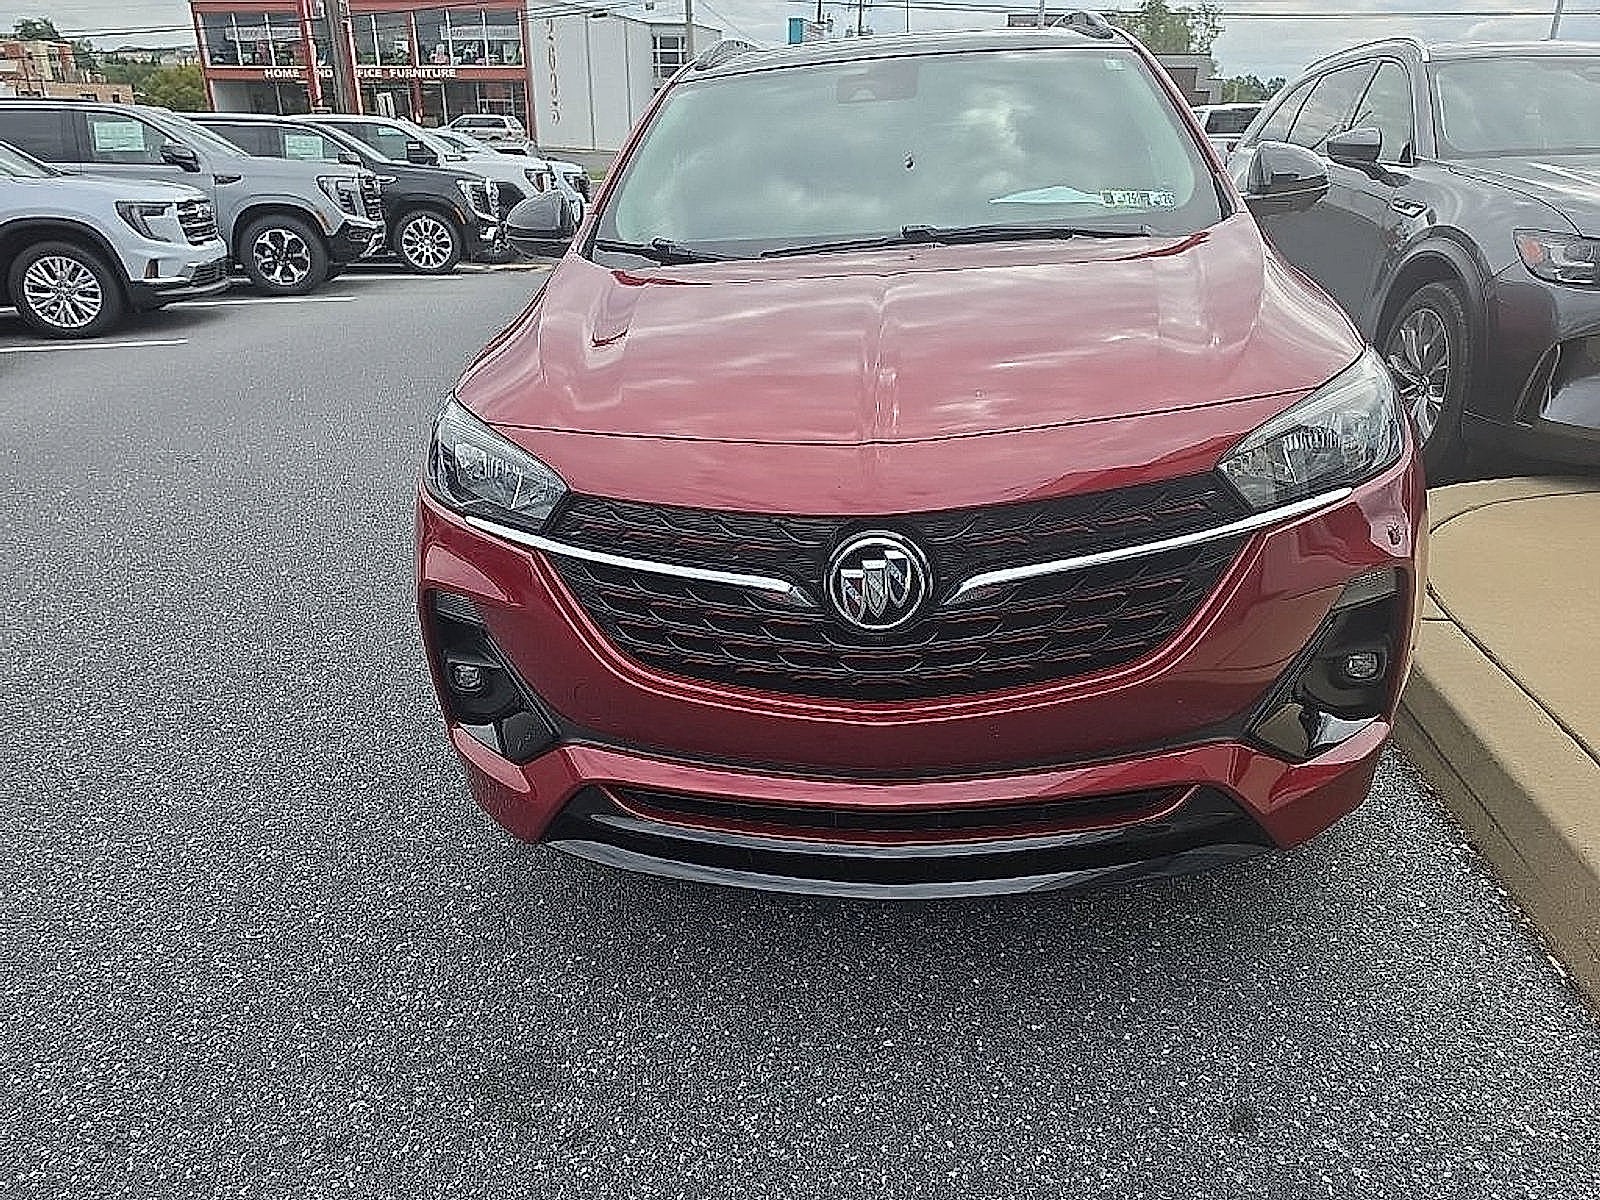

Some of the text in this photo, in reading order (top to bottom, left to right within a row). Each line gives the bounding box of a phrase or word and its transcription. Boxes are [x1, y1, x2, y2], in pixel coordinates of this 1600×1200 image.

[264, 68, 301, 78] HOME
[357, 68, 382, 78] FICE
[389, 68, 457, 78] FURNITURE
